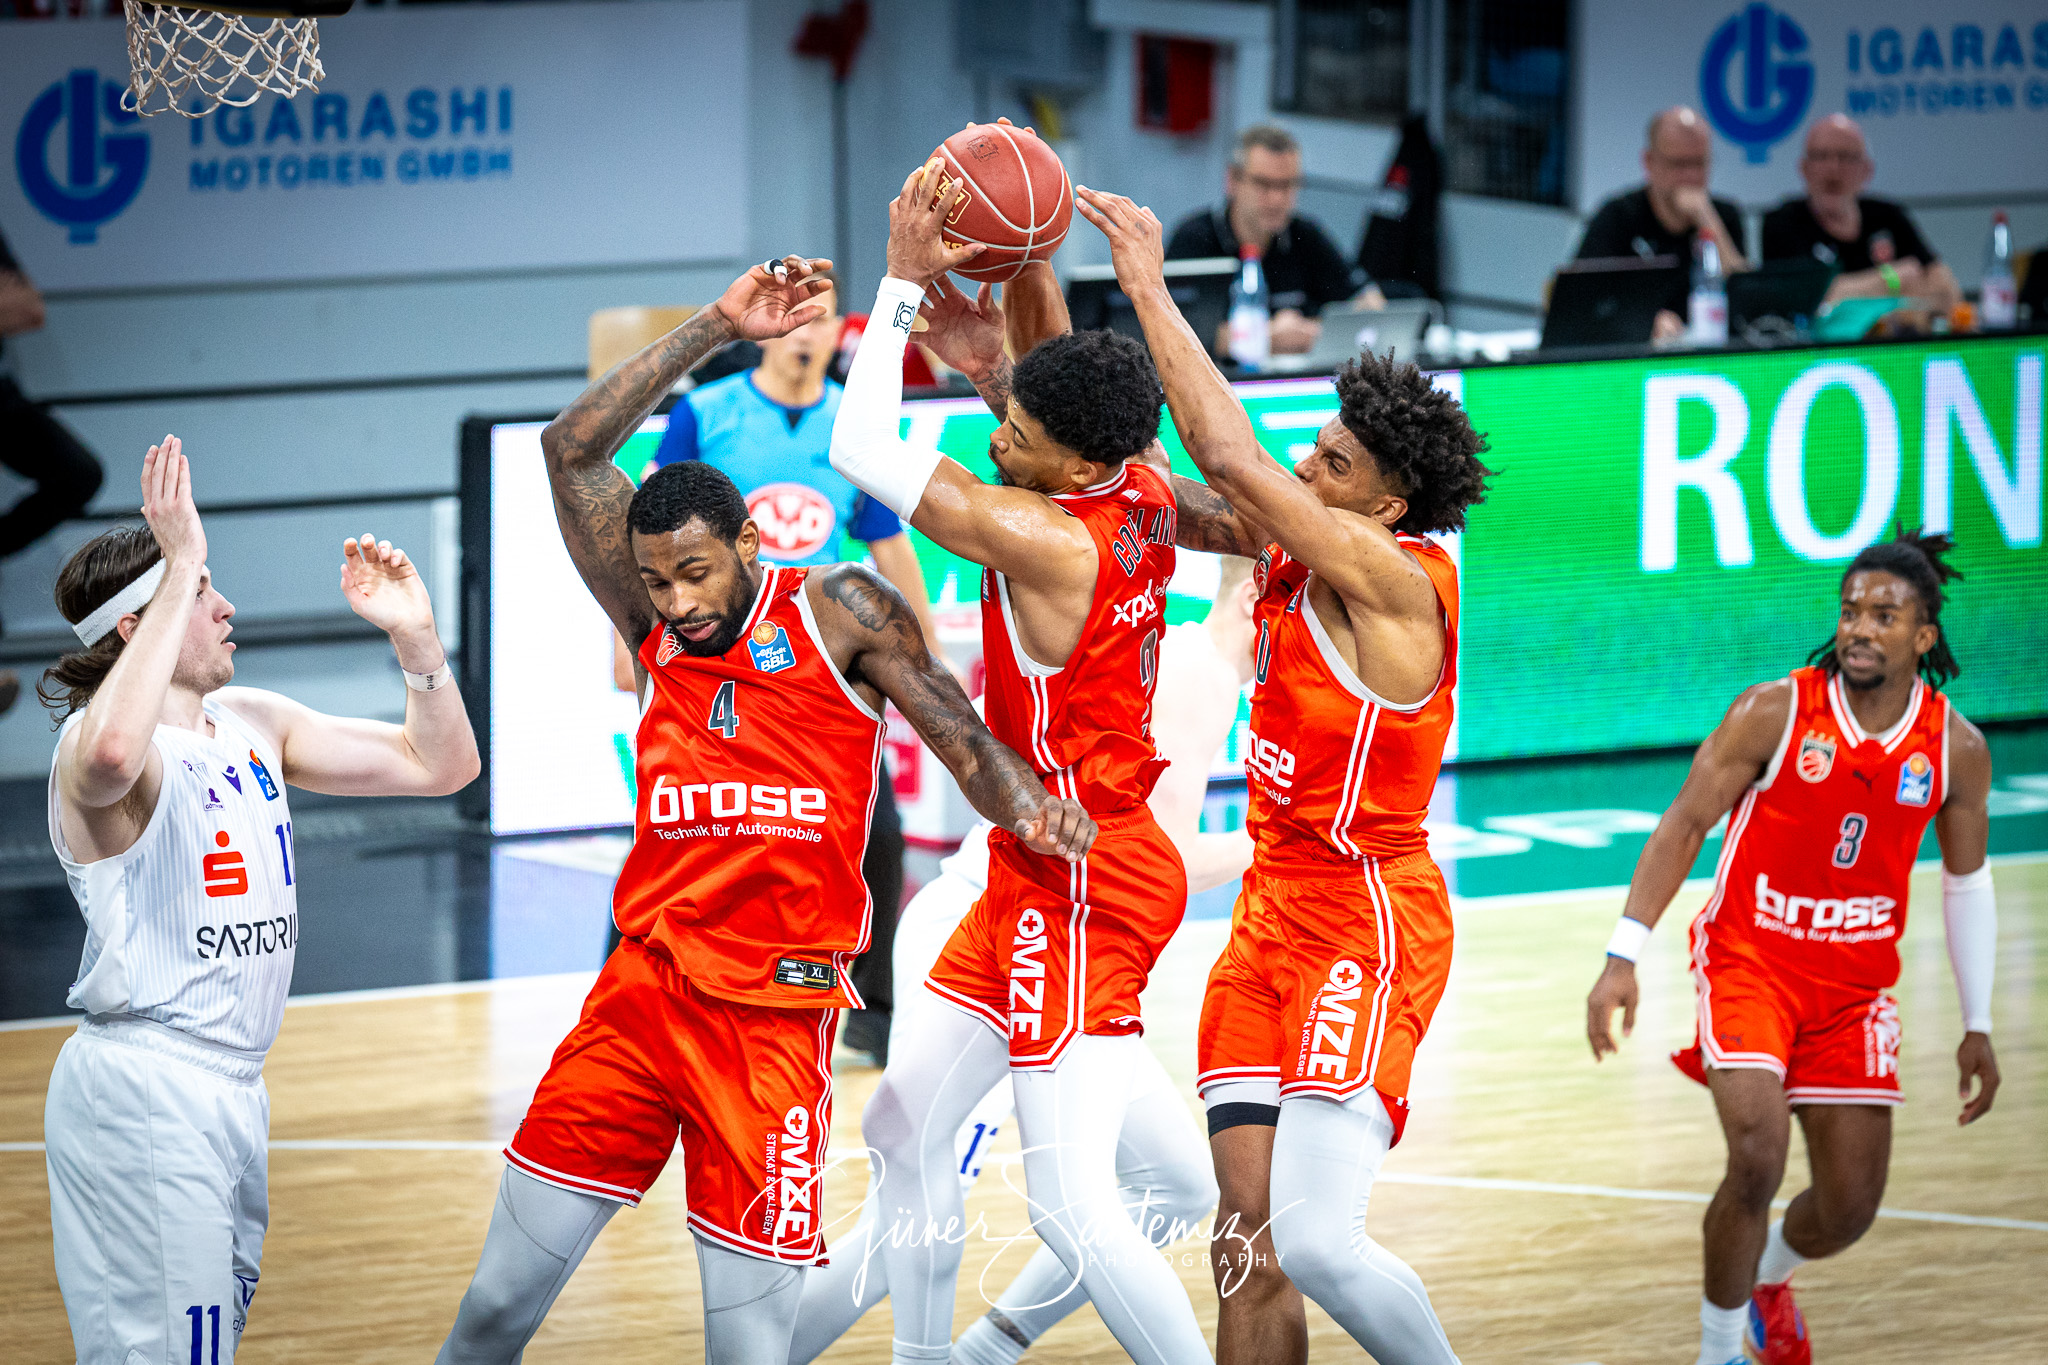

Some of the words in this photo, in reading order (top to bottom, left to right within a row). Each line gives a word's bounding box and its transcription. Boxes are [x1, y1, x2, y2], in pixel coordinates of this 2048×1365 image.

[189, 87, 512, 146] IGARASHI
[190, 156, 384, 191] MOTOREN
[1640, 351, 2044, 572] RON
[760, 654, 790, 672] BBL
[708, 681, 740, 739] 4
[649, 774, 827, 824] brose
[654, 824, 710, 840] Technik
[711, 823, 731, 837] für
[735, 822, 823, 843] Automobile
[1831, 812, 1869, 870] 3
[1755, 872, 1897, 930] brose
[811, 966, 824, 979] XL
[765, 1133, 777, 1175] STIRKAT
[761, 1185, 777, 1236] KOLLEGEN
[185, 1305, 221, 1365] 11
